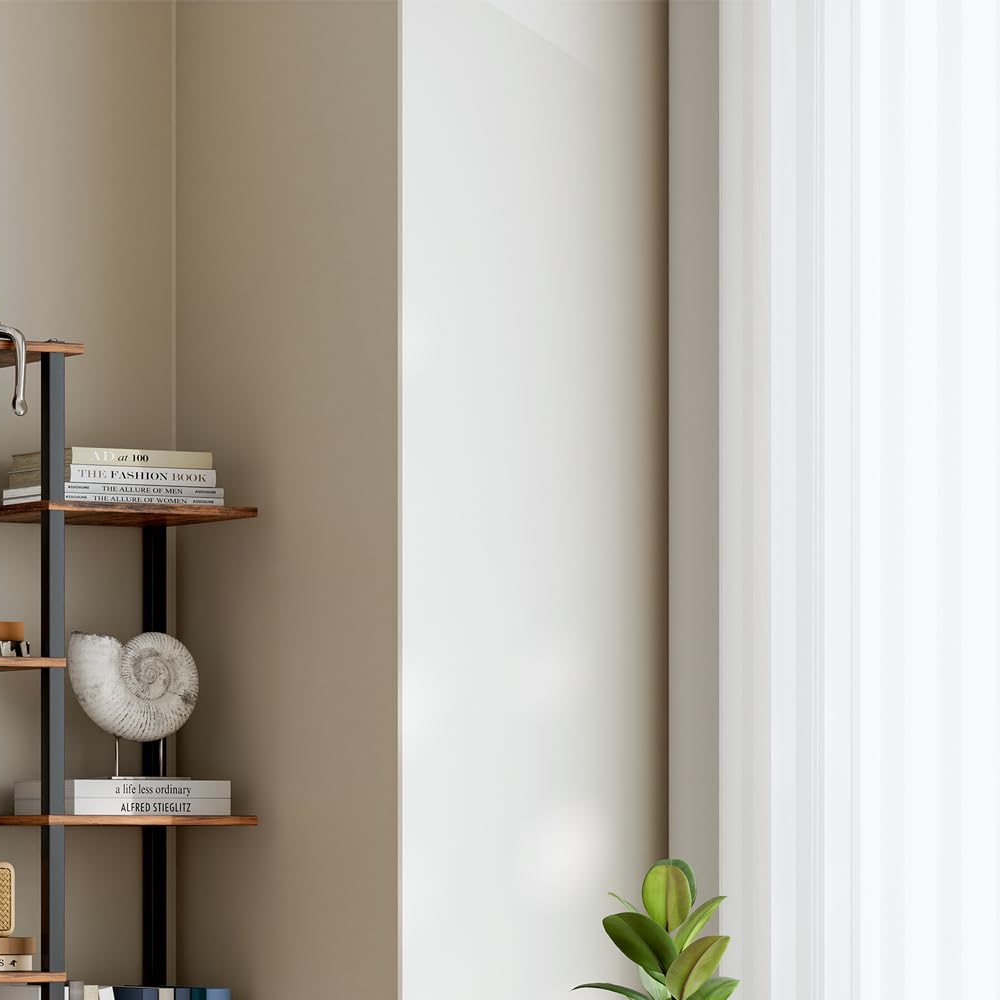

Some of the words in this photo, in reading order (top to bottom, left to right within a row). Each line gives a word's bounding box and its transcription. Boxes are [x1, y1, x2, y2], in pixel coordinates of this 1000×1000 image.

[90, 451, 115, 462] AD
[118, 453, 128, 462] at
[132, 454, 149, 462] 100
[78, 469, 107, 479] THE
[111, 470, 168, 481] FASHION
[172, 472, 207, 483] BOOK
[115, 786, 121, 794] a
[122, 784, 136, 794] life
[138, 784, 153, 794] less
[155, 784, 192, 797] ordinary
[120, 802, 151, 813] ALFRED
[153, 802, 192, 813] STIEGLITZ
